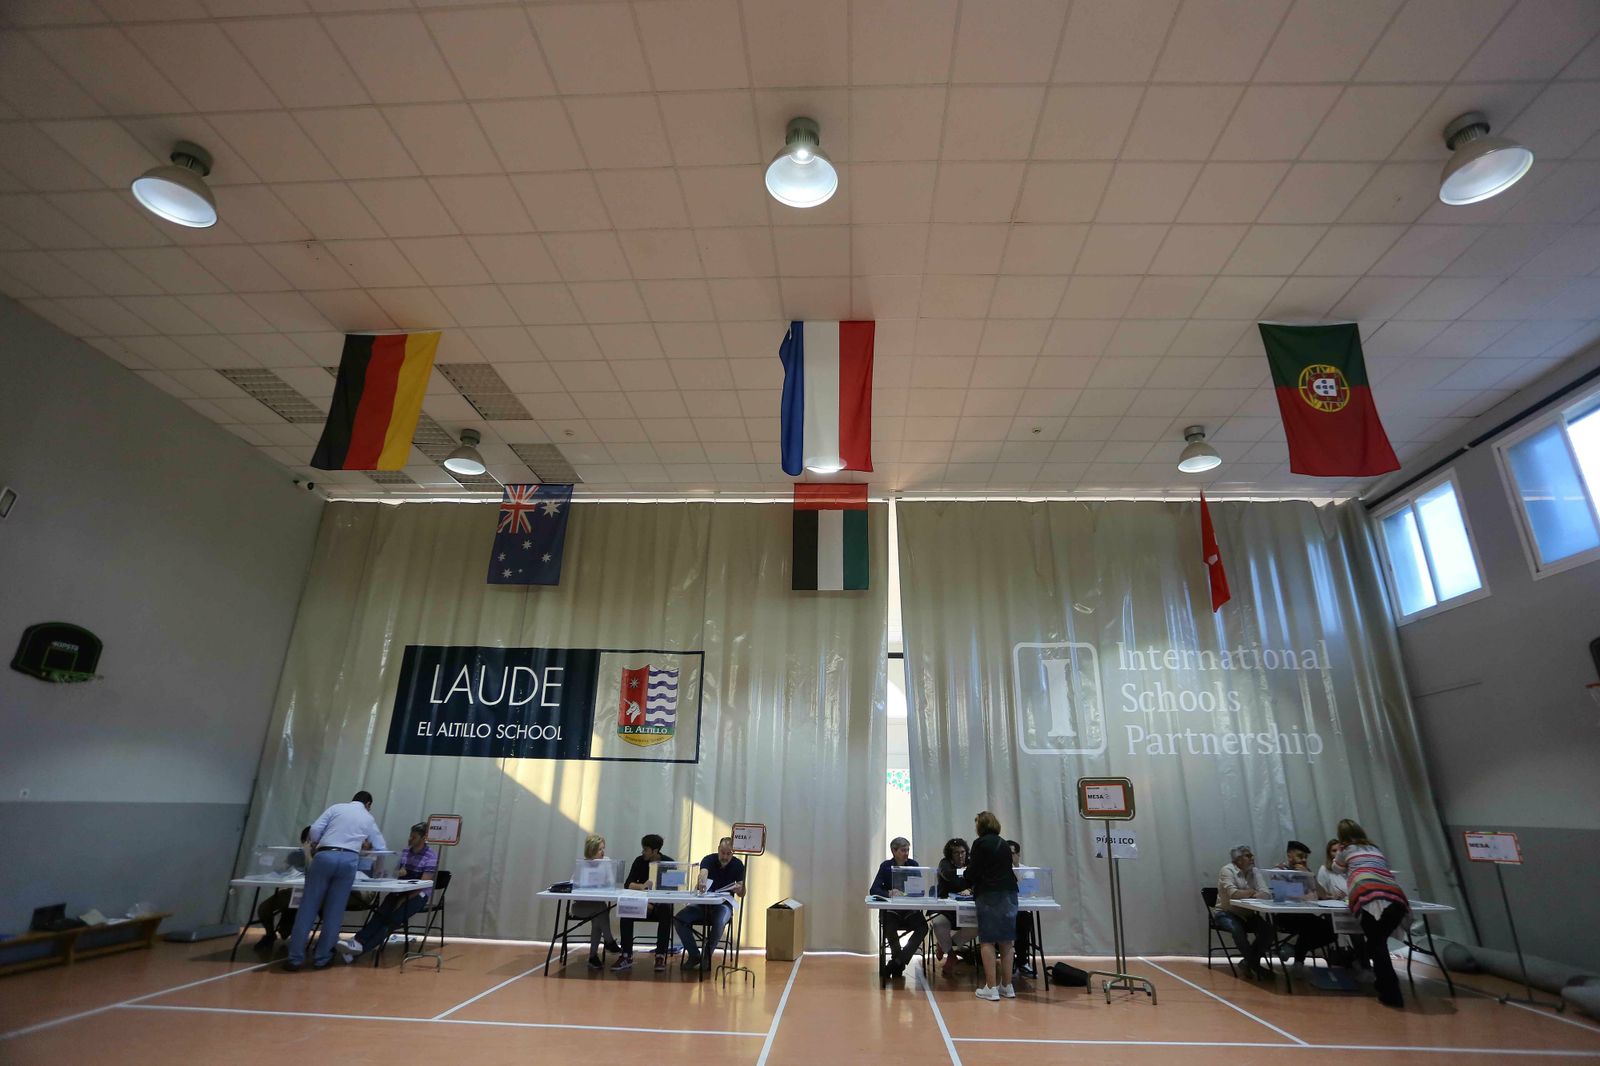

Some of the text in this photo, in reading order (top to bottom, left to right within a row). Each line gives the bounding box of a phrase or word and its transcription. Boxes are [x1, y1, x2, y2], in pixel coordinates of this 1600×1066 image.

[1116, 640, 1333, 671] International
[429, 664, 564, 707] LAUDE
[1122, 682, 1241, 712] Schools
[417, 722, 562, 741] EL ALTILLO SCHOOL
[624, 725, 668, 734] EL ALTILLO
[1126, 722, 1324, 764] Partnership
